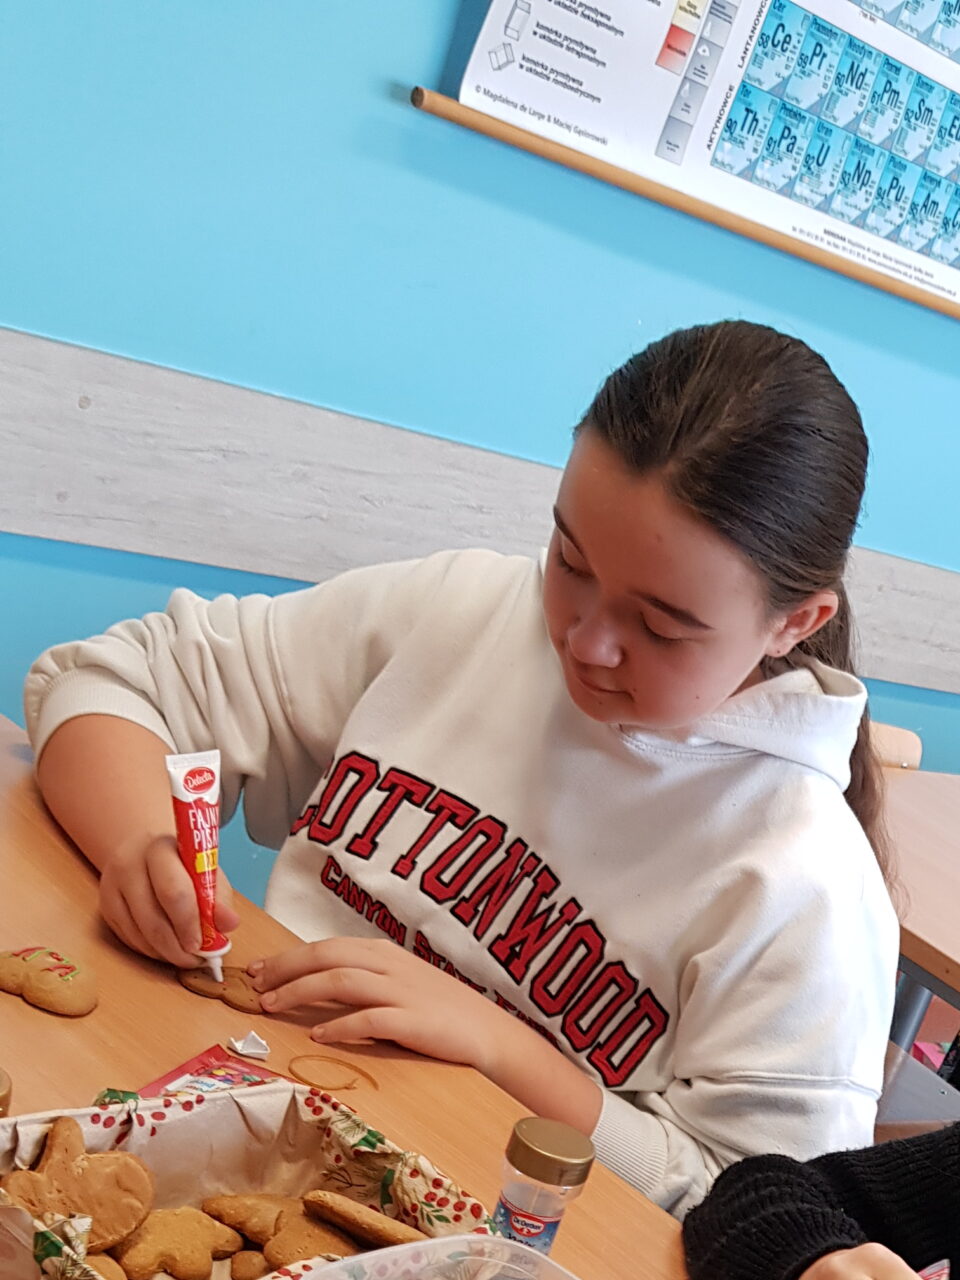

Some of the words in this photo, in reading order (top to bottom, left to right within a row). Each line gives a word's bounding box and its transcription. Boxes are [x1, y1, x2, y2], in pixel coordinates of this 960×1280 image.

[738, 0, 768, 68] LANTANOWC
[771, 22, 792, 53] Ce
[809, 42, 828, 70] Pr
[846, 60, 868, 90] Nd
[880, 79, 900, 109] Pm
[706, 84, 735, 152] AKTYNOWCE
[740, 107, 759, 137] Th
[914, 98, 933, 126] Sm
[778, 125, 797, 154] Pa
[815, 142, 831, 167] U
[852, 160, 872, 191] Np
[887, 177, 905, 203] Pu
[920, 193, 940, 219] Am
